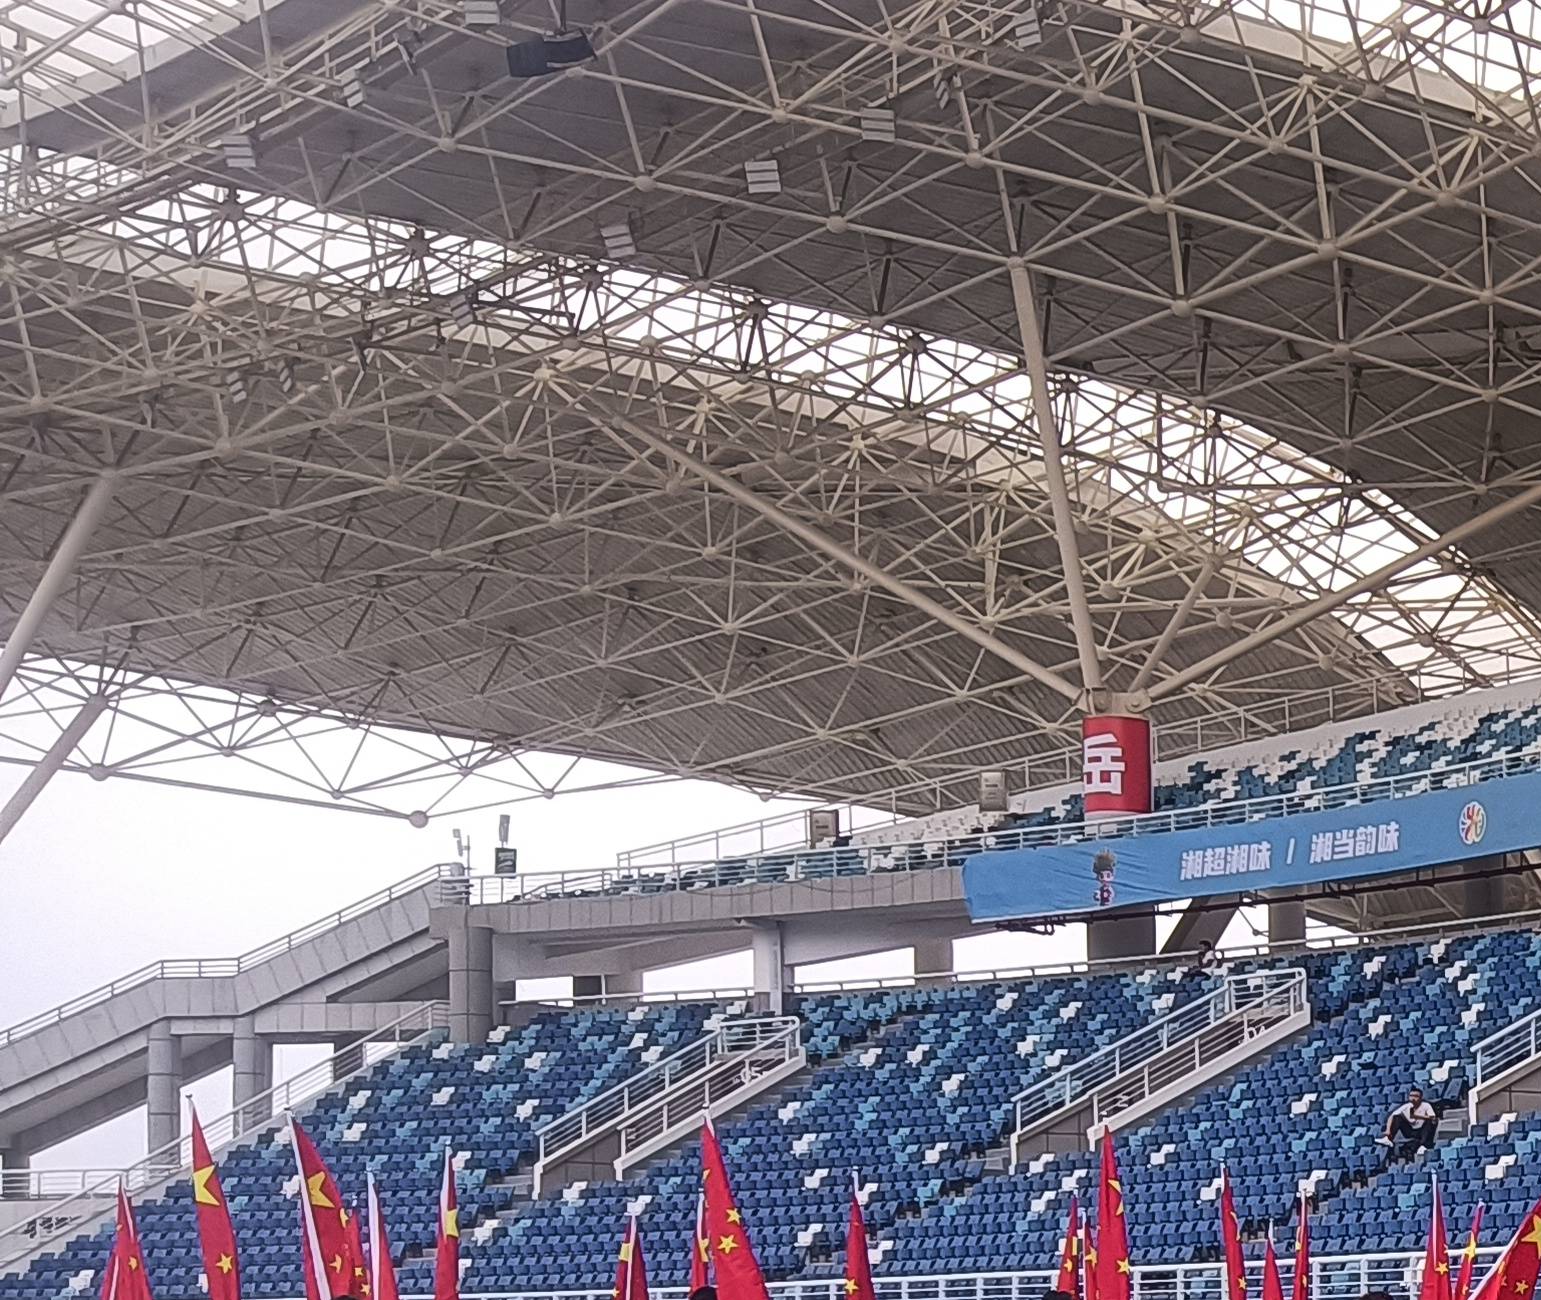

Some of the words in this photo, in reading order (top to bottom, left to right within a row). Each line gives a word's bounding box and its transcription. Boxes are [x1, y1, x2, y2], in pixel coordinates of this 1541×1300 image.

[1180, 840, 1272, 880] 湘超湘味
[1309, 820, 1400, 864] 湘当韵味
